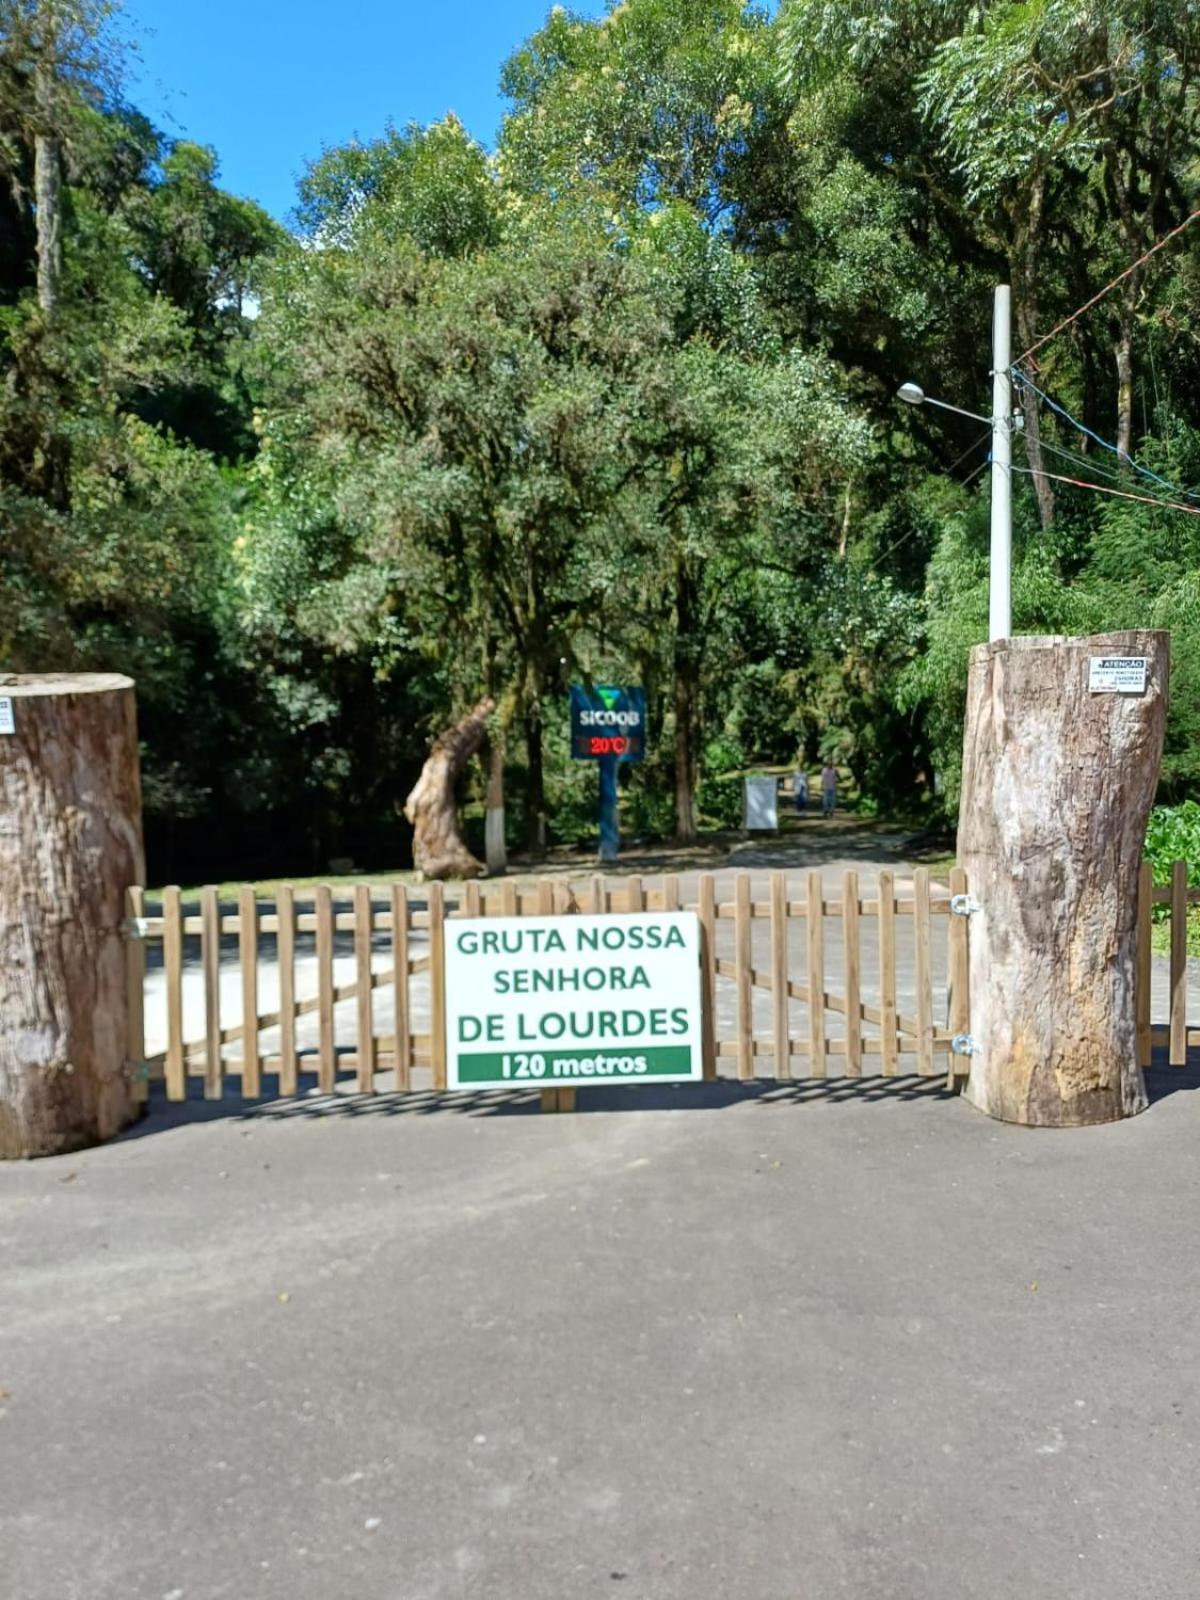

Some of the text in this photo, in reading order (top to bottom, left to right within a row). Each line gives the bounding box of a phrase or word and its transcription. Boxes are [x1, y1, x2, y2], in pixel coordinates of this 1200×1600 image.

[457, 925, 686, 955] GRUTA NOSSA
[494, 965, 651, 994] SENHORA
[458, 1007, 689, 1042] DE LOURDES
[502, 1054, 647, 1078] 120 metros
